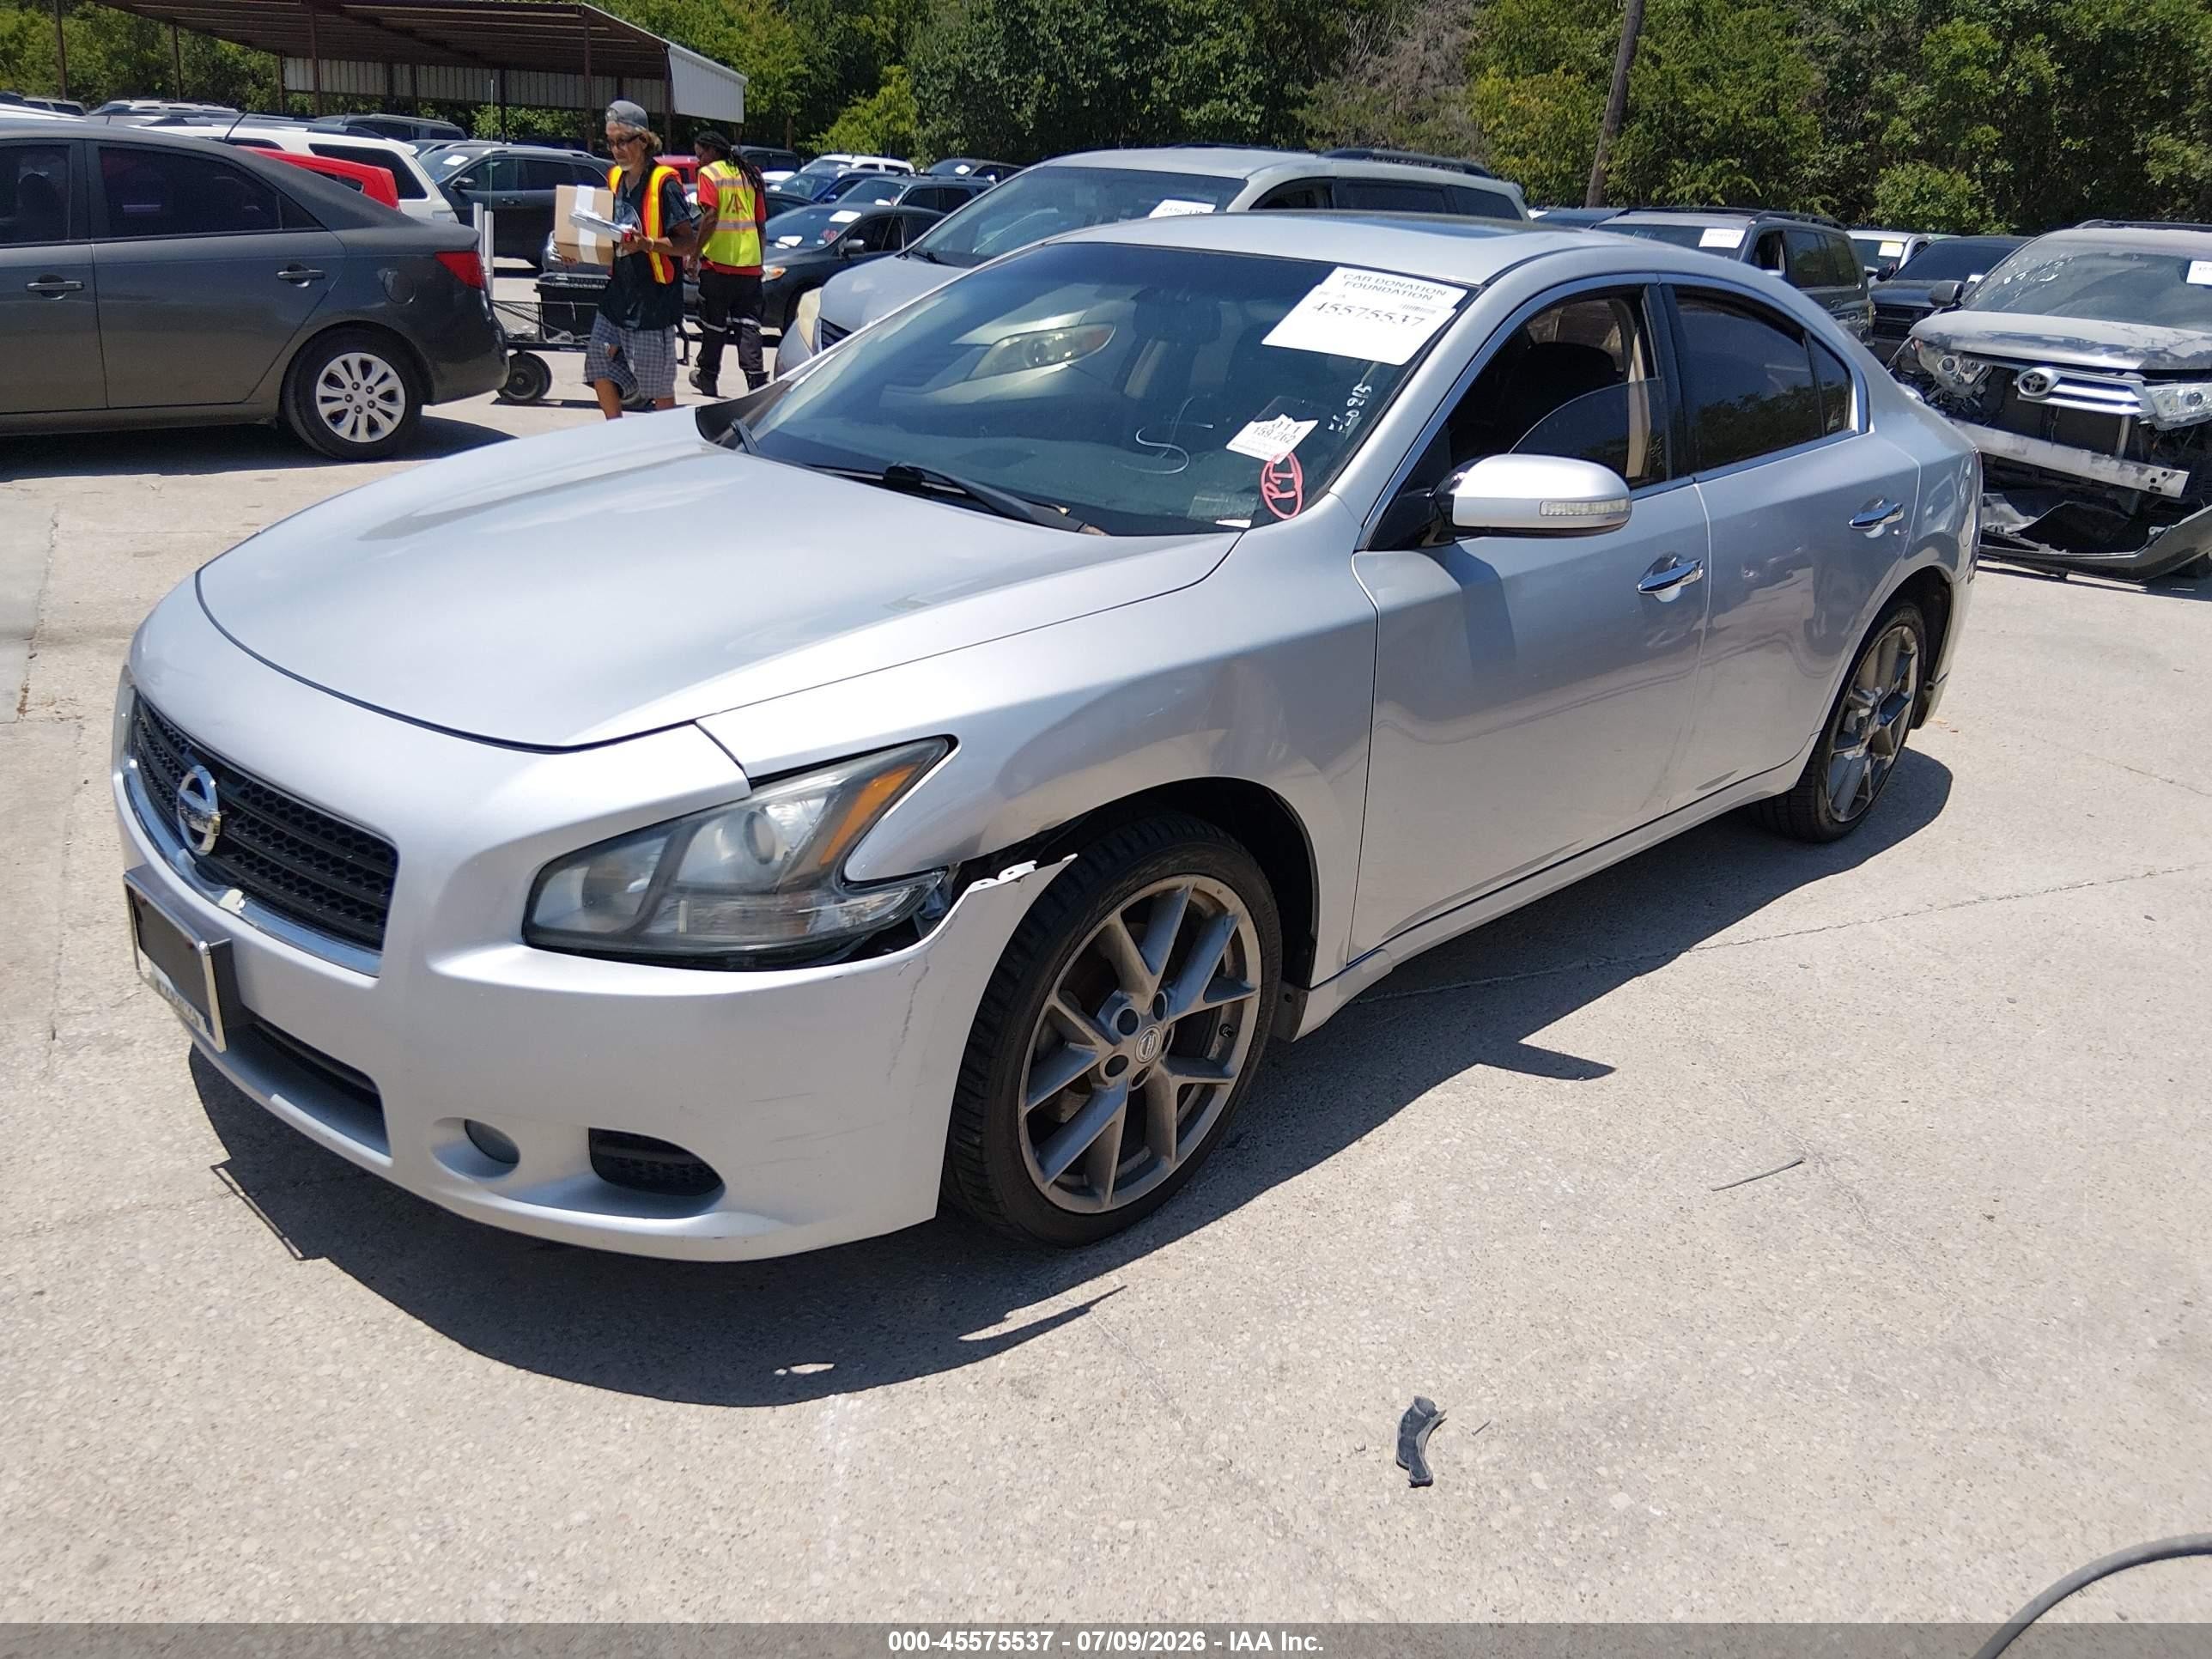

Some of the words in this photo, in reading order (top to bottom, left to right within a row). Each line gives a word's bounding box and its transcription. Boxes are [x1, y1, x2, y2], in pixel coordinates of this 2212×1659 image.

[1343, 274, 1372, 283] CAR
[1375, 278, 1448, 297] DONATION
[1343, 281, 1433, 301] FOUNDATION
